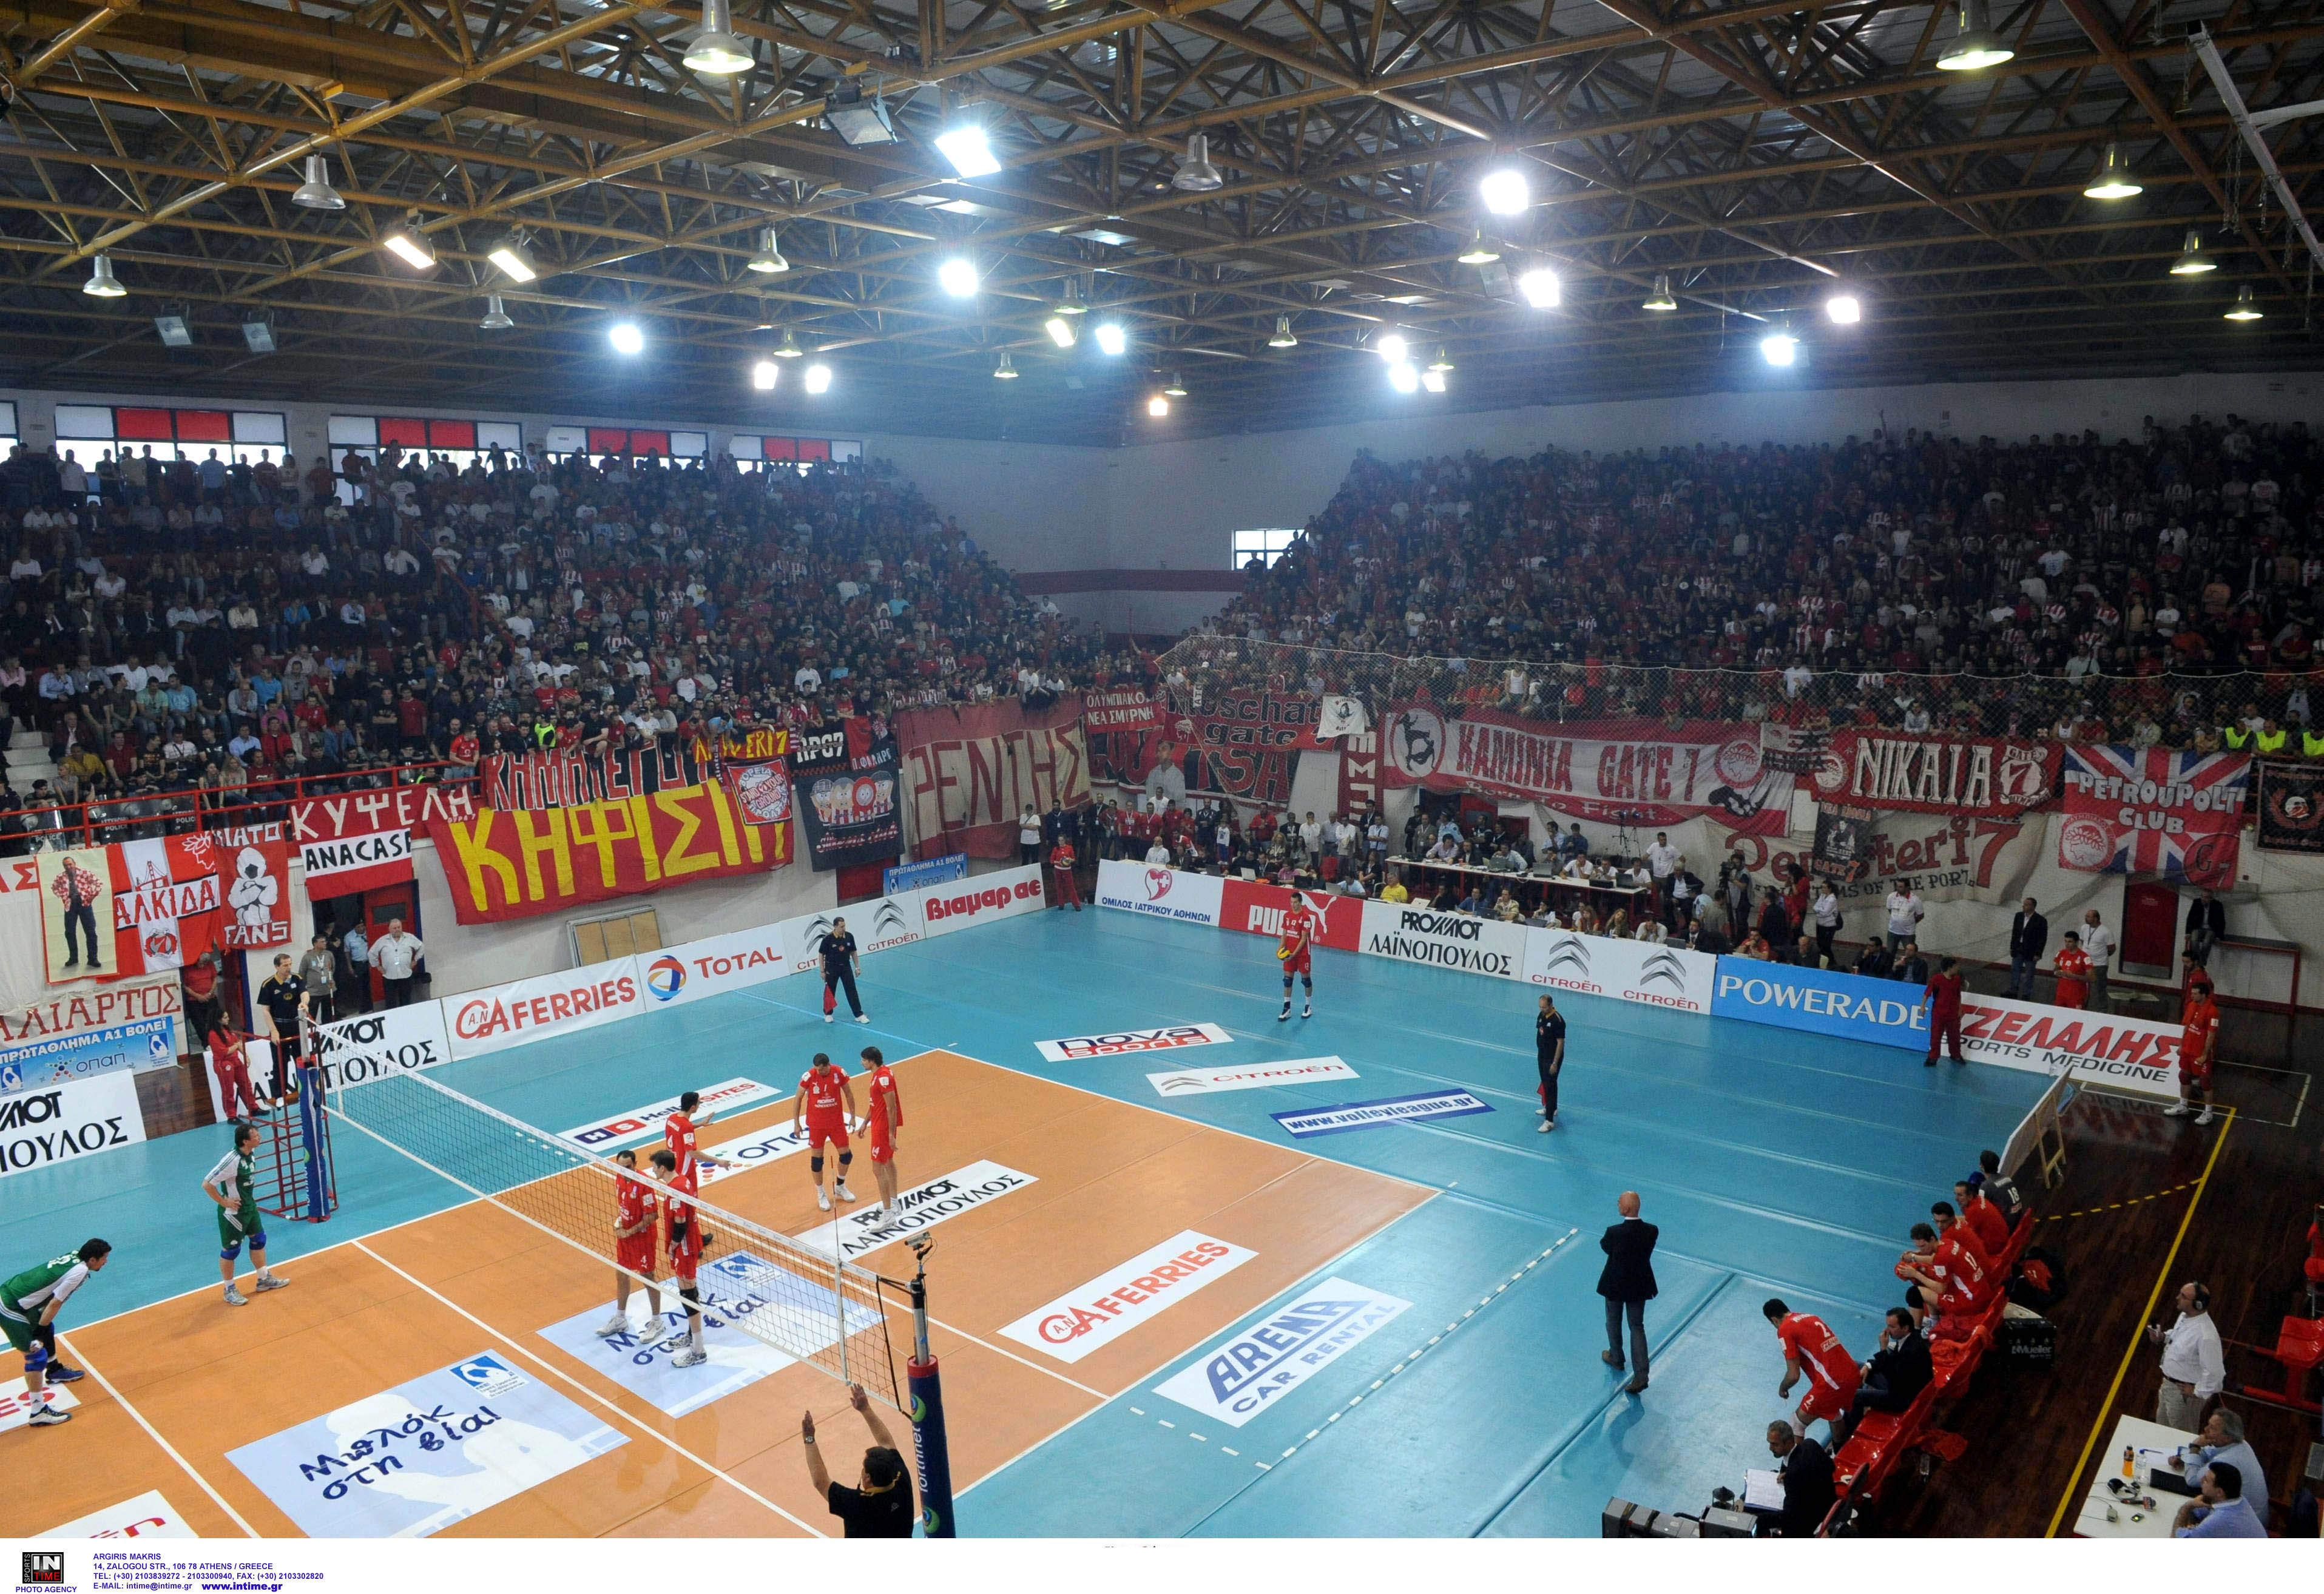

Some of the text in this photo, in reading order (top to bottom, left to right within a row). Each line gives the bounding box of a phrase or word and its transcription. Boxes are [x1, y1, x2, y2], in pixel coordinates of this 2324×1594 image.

[1087, 692, 1152, 708] ΟΛΥΜΠΙΑΚΟ
[1088, 706, 1154, 725] ΝΕΑ ΣΜΥΡΝΗ
[1167, 694, 1322, 724] moschat
[1204, 723, 1297, 746] gate
[1458, 723, 1573, 792] KAMINIA
[1597, 744, 1674, 801] GATE
[1851, 737, 1993, 808] NIKAIA
[740, 774, 783, 803] STAND YOUR
[910, 721, 1090, 842] ΡΕΝΤΗΣ
[2078, 772, 2238, 814] PETROUPOLI
[291, 785, 473, 840] ΚΥΨΕΛΗ
[756, 789, 782, 809] GROUND
[2118, 808, 2184, 834] CLUB
[889, 861, 935, 876] ΠΡΩΤΑΘΛΗΜΑ
[1725, 817, 2025, 888] Perteri 7
[2195, 844, 2214, 872] G
[115, 880, 215, 928] ΑΛΚΙΔΑ
[1102, 896, 1211, 923] ΟΜΙΛΟΣ ΙΑΤΡΙΚΟΥ ΑΘΗΝΩΝ
[225, 920, 288, 945] FANS
[1248, 905, 1316, 941] PU
[694, 947, 782, 979] TOTAL
[1369, 932, 1512, 976] ΛΑΪΝΟΠΟΥΛΟΣ
[512, 977, 636, 1030] FERRIES
[1718, 974, 1929, 1031] POWERADE
[0, 1035, 102, 1063] ΠΡΩΤΑΘΛΗΜΑ
[126, 1019, 167, 1037] ΒΟΛΕΪ
[1068, 1036, 1208, 1057] sports
[2043, 1052, 2169, 1082] MEDICINE
[1286, 1096, 1477, 1129] www.volleyleague.gr
[871, 1146, 880, 1155] 14
[641, 1255, 647, 1263] 4
[1093, 1242, 1229, 1316] FERRIES
[1814, 1322, 1831, 1338] 2
[1206, 1300, 1371, 1404] ARENA
[1232, 1305, 1395, 1413] CAR RENTAL
[1806, 1394, 1814, 1405] 2
[323, 1455, 404, 1499] στη
